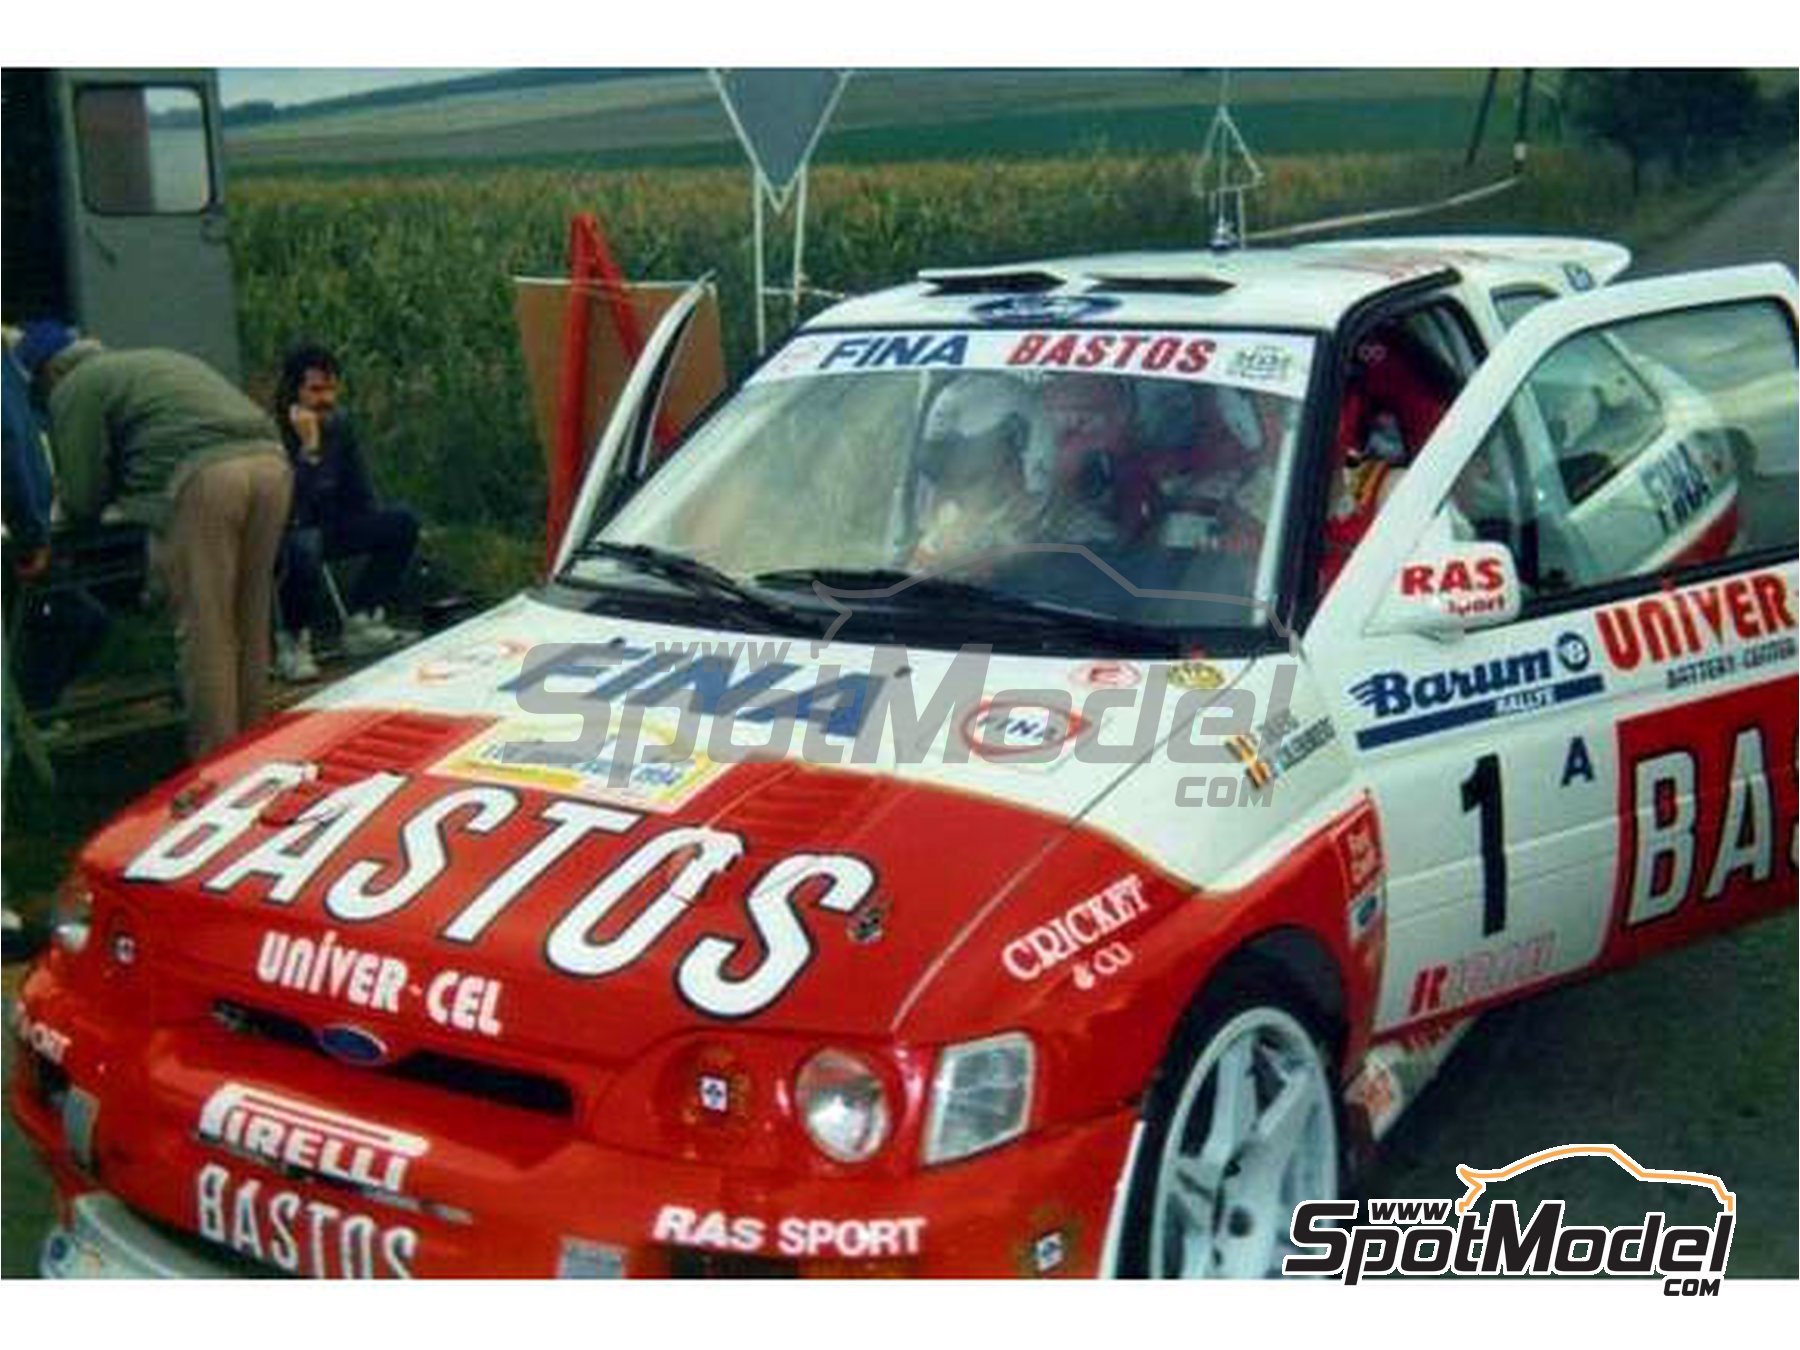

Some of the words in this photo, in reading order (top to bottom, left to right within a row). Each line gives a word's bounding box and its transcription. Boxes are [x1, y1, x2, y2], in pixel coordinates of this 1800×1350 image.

[818, 334, 970, 368] FINA
[1006, 334, 1217, 373] BASTOS
[1401, 558, 1506, 596] RAS
[498, 640, 894, 736] FINA
[1349, 648, 1553, 717] Barum
[1561, 736, 1594, 786] A
[1461, 753, 1506, 936] 1
[1626, 726, 1799, 926] BA
[122, 760, 877, 1019] BASTOS
[1002, 873, 1151, 981] CRICKET
[199, 1083, 430, 1192] PIRELLI
[197, 1164, 418, 1279] BASTOS
[652, 1206, 766, 1254] RAS
[778, 1216, 928, 1257] SPORT
